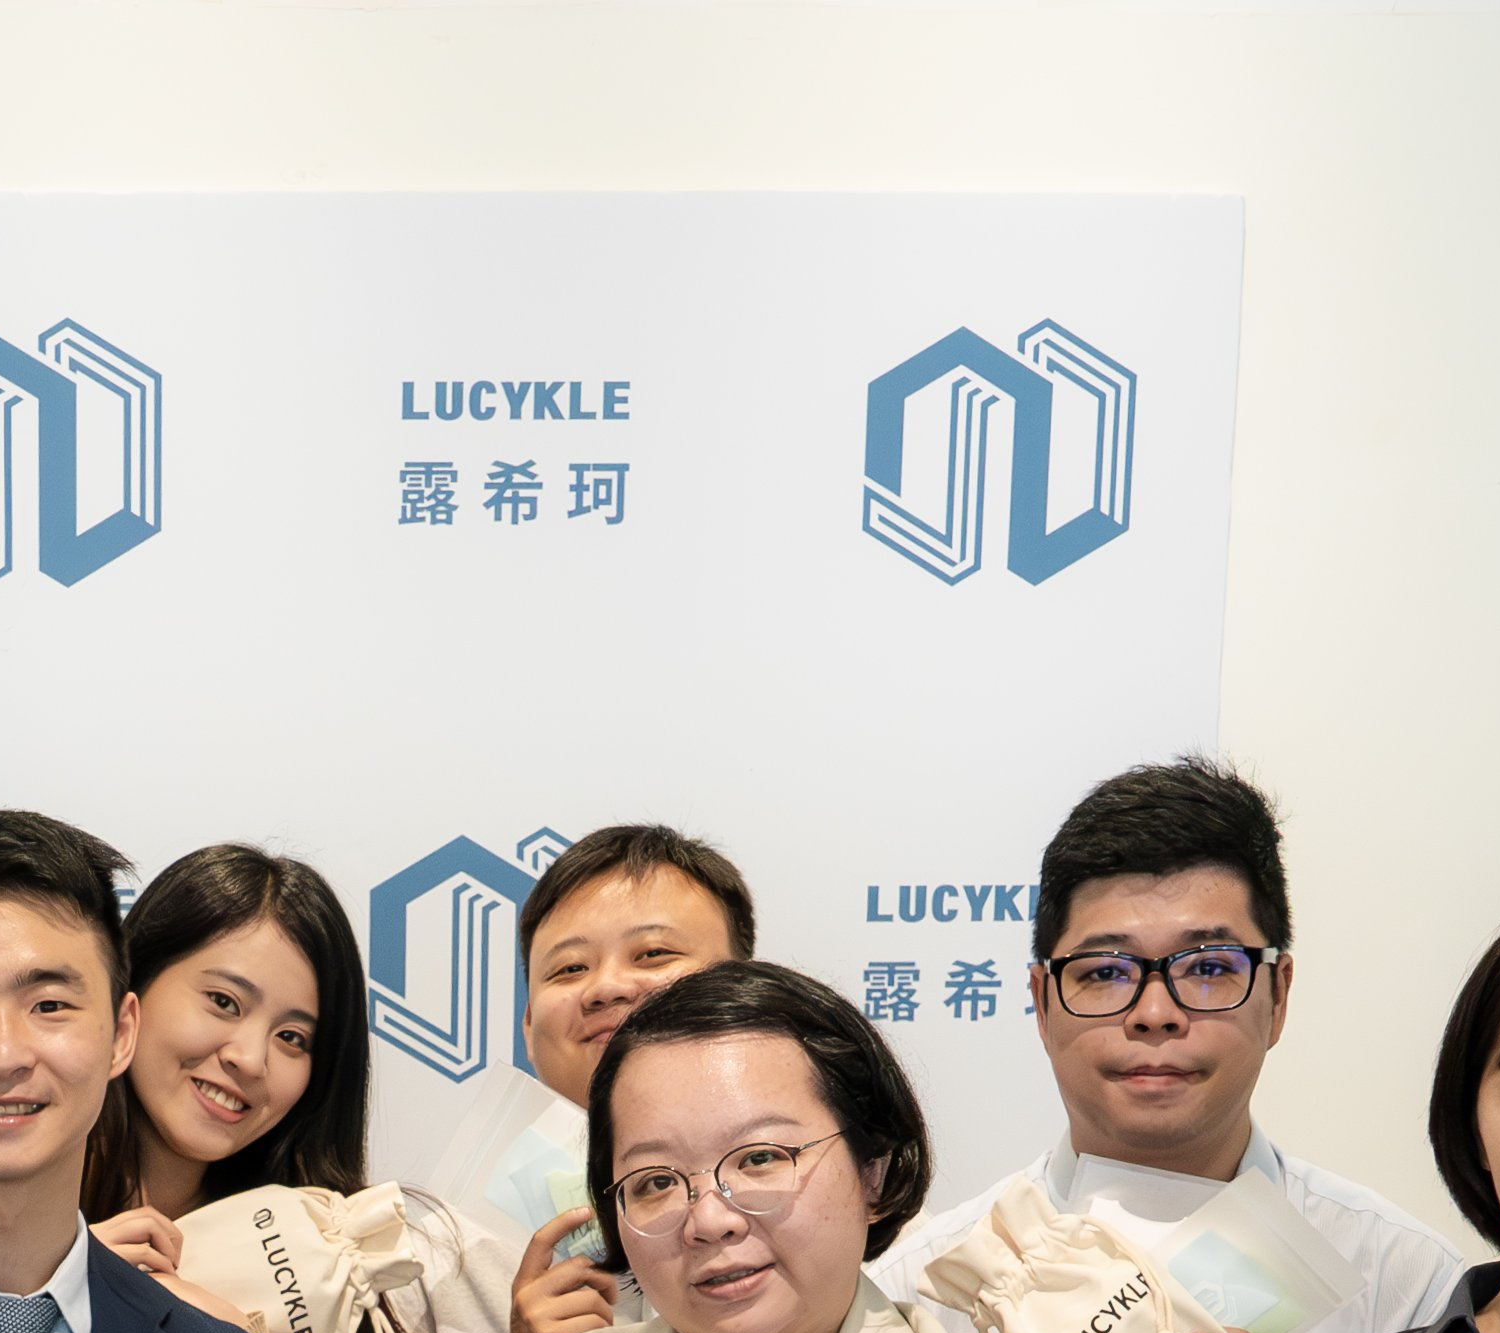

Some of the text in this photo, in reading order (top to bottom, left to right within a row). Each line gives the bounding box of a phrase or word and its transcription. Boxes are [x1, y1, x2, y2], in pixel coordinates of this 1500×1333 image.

[402, 381, 631, 421] LUCYKLE
[399, 460, 631, 525] 露希珂
[863, 959, 1036, 1022] 露希
